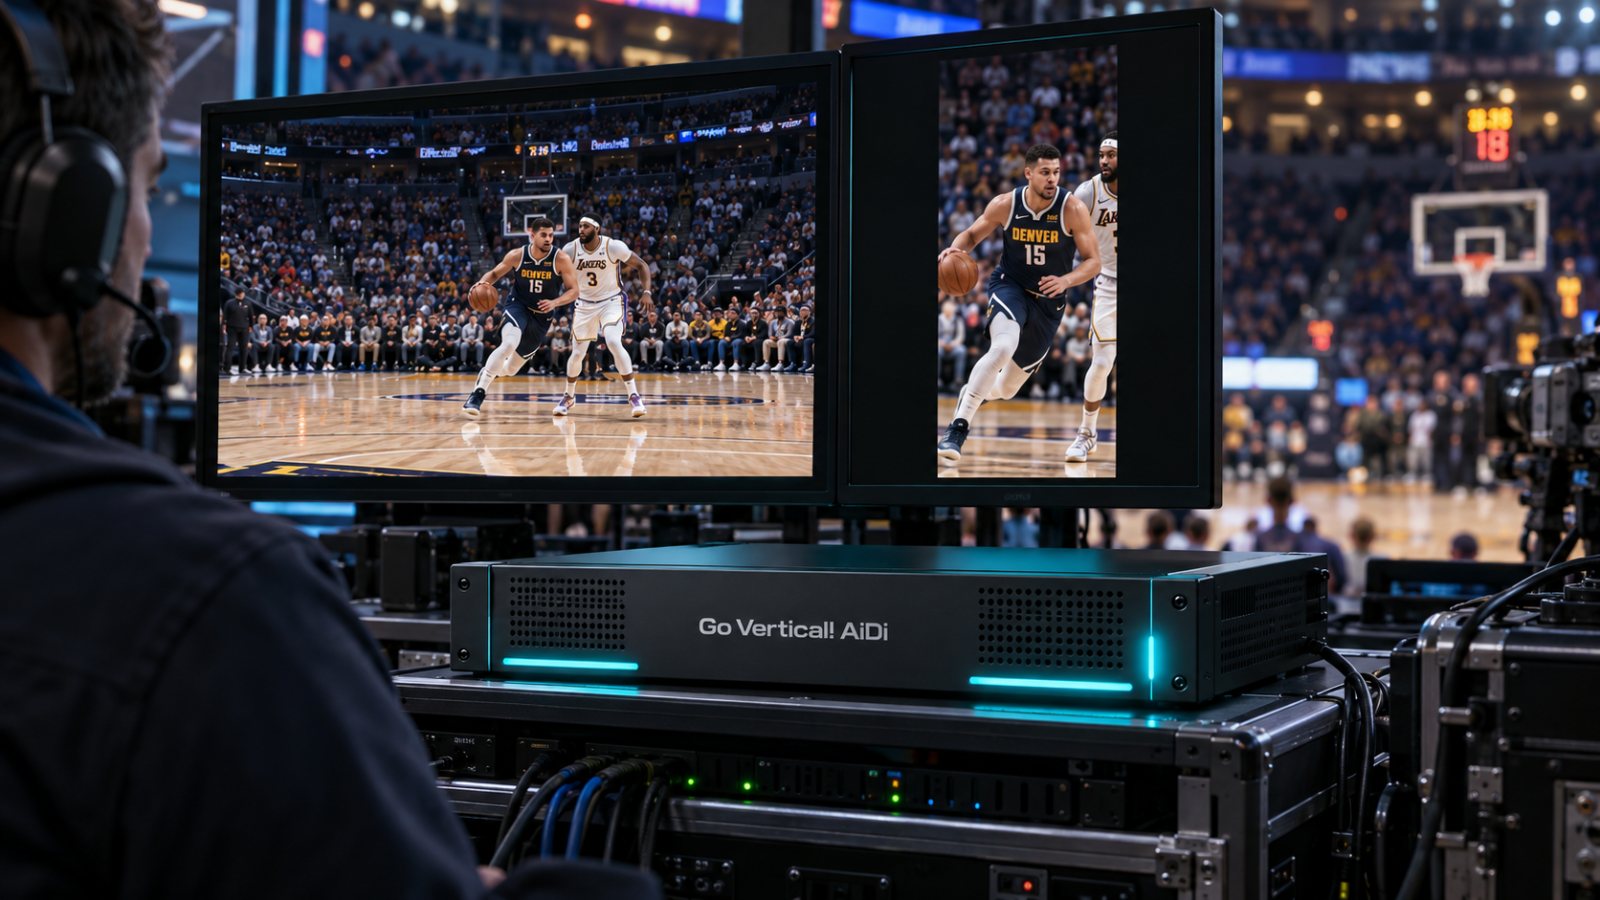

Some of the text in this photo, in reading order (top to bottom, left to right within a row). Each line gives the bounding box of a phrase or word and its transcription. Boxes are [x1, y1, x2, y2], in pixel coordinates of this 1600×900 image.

[1476, 130, 1509, 161] 18
[1012, 227, 1059, 243] DENVER
[1024, 244, 1046, 265] 15
[576, 259, 607, 271] LAKERS
[521, 269, 552, 280] DENVER
[586, 272, 598, 287] 3
[528, 279, 543, 294] 15
[698, 617, 889, 641] Go Vertical! AiDi
